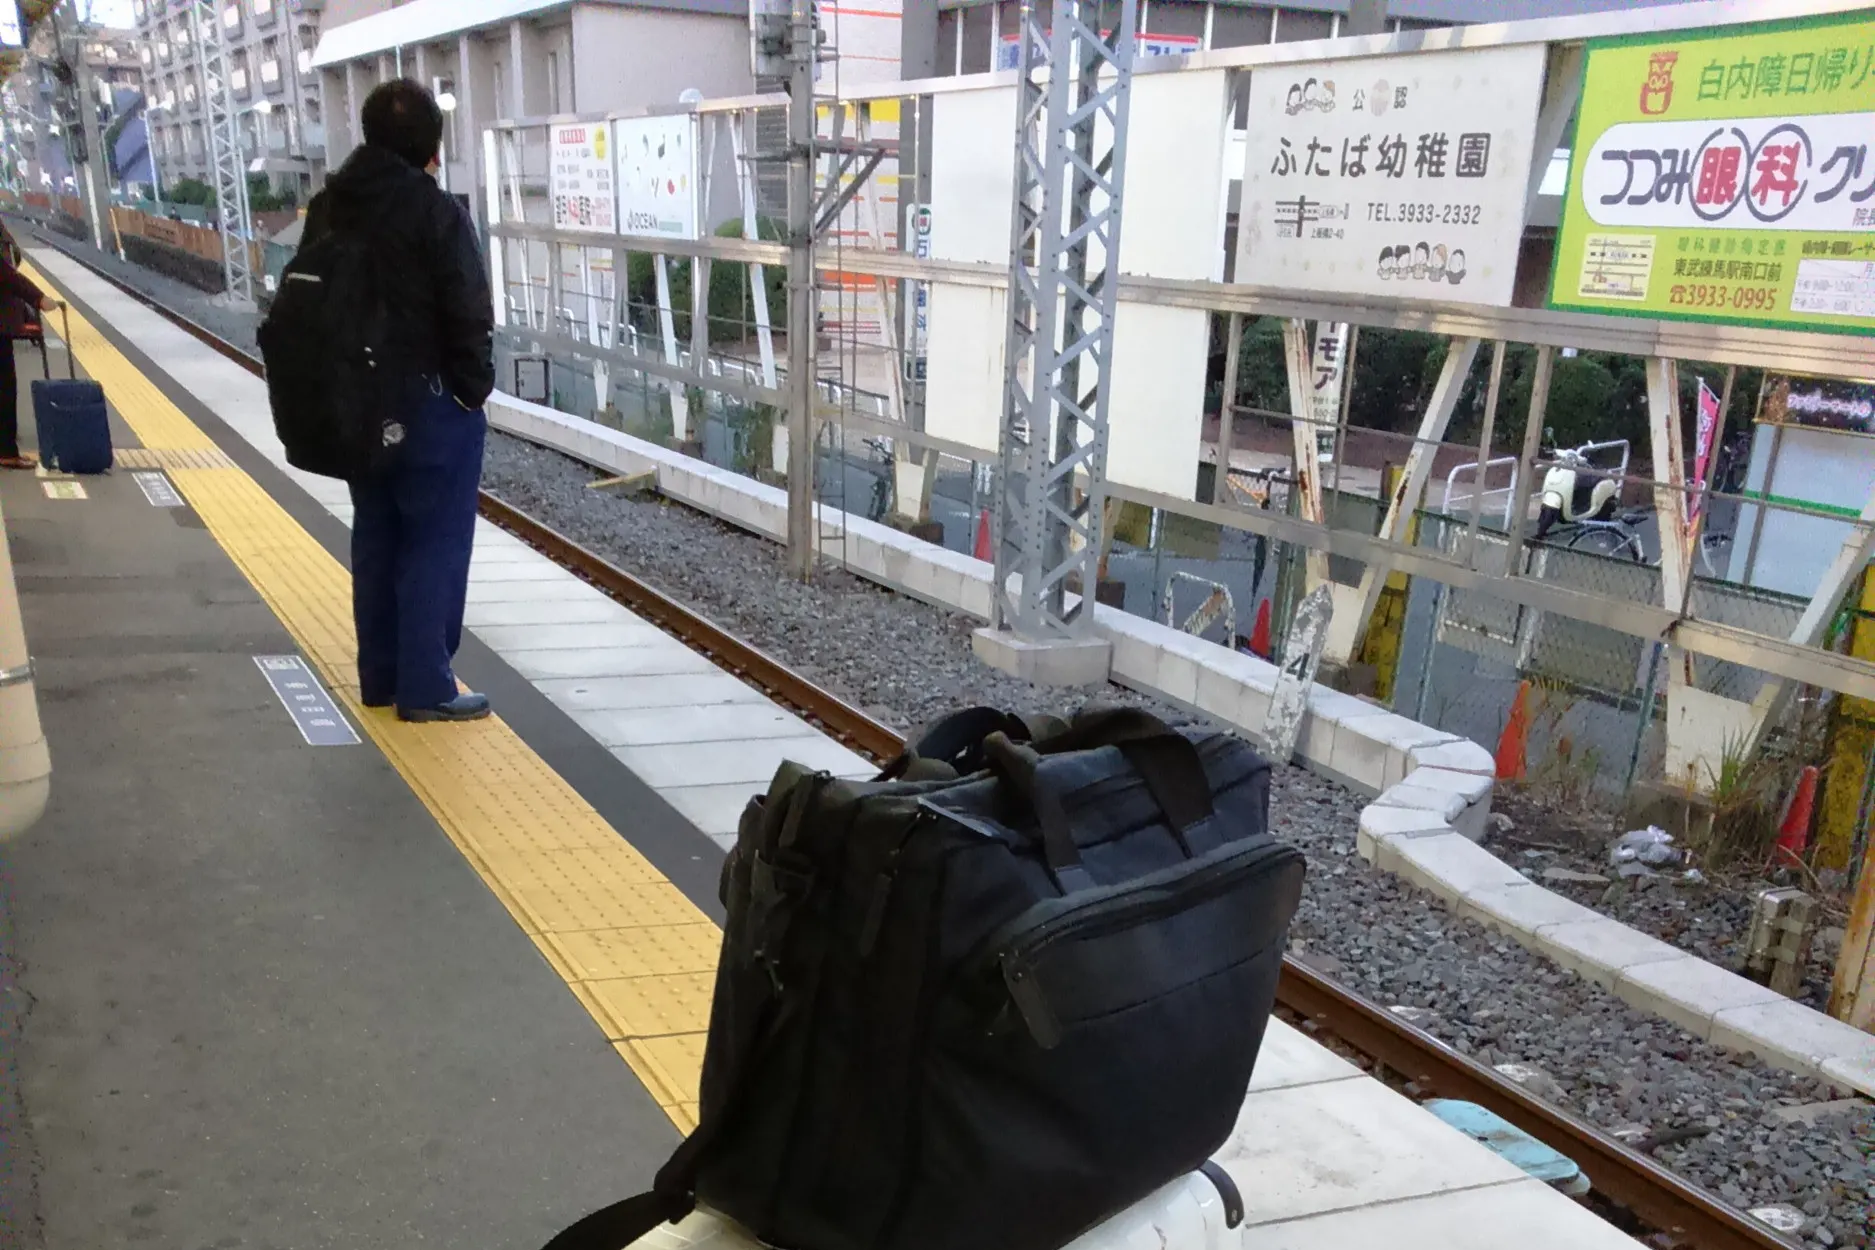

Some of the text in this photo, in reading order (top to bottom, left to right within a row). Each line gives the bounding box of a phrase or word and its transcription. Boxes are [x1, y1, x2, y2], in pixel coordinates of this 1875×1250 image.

[1696, 45, 1874, 102] 白内障日帰り
[1352, 88, 1365, 111] 公
[1271, 132, 1491, 178] ふたば幼稚園
[1367, 202, 1482, 225] TEL.3933-2332
[1286, 653, 1310, 681] 4
